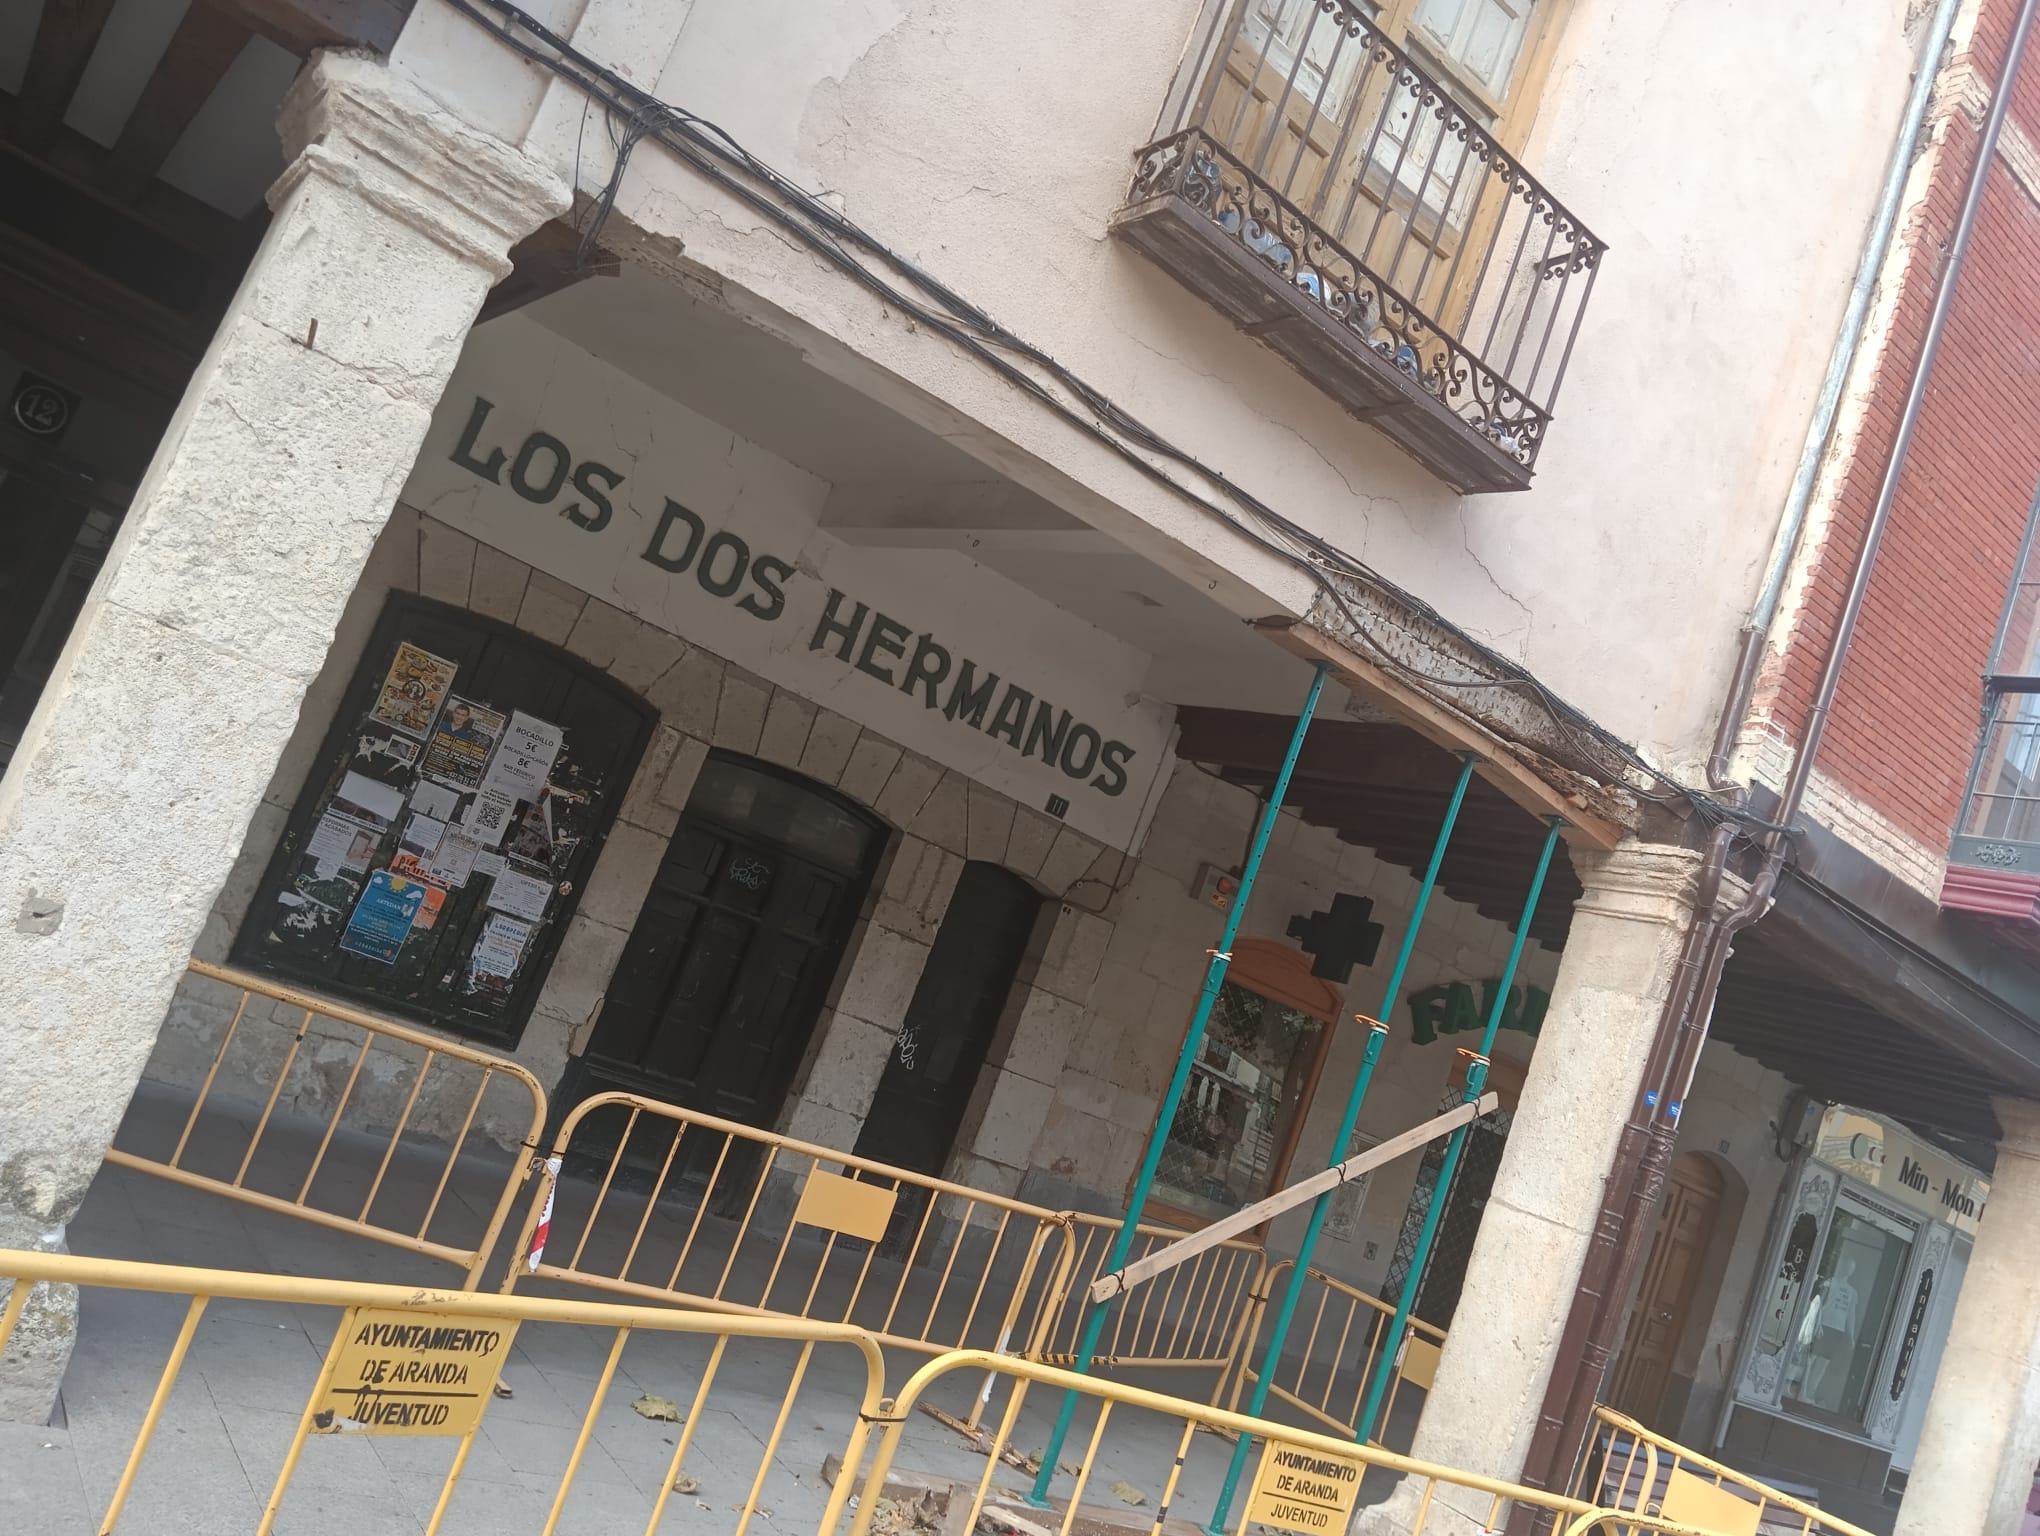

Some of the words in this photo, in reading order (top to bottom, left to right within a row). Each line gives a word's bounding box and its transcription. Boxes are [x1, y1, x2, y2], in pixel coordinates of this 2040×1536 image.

[25, 394, 58, 426] 12
[448, 395, 626, 533] LOS
[640, 495, 796, 621] DOS
[809, 588, 1136, 797] HERMANOS
[515, 726, 554, 747] BOCADILLO
[525, 742, 538, 752] 5€
[517, 757, 531, 768] 8€
[1898, 1156, 1928, 1194] Min
[1941, 1178, 1974, 1217] Mon
[354, 1323, 500, 1356] AYUNTAMIENTO
[359, 1359, 391, 1384] DE
[388, 1360, 468, 1384] ARANDA
[348, 1393, 449, 1426] JUVENTUD
[1273, 1451, 1357, 1482] AYUNTAMIENTO
[1276, 1474, 1294, 1491] DE
[1293, 1481, 1338, 1502] ARANDA
[1270, 1503, 1328, 1528] JUVENTUD
